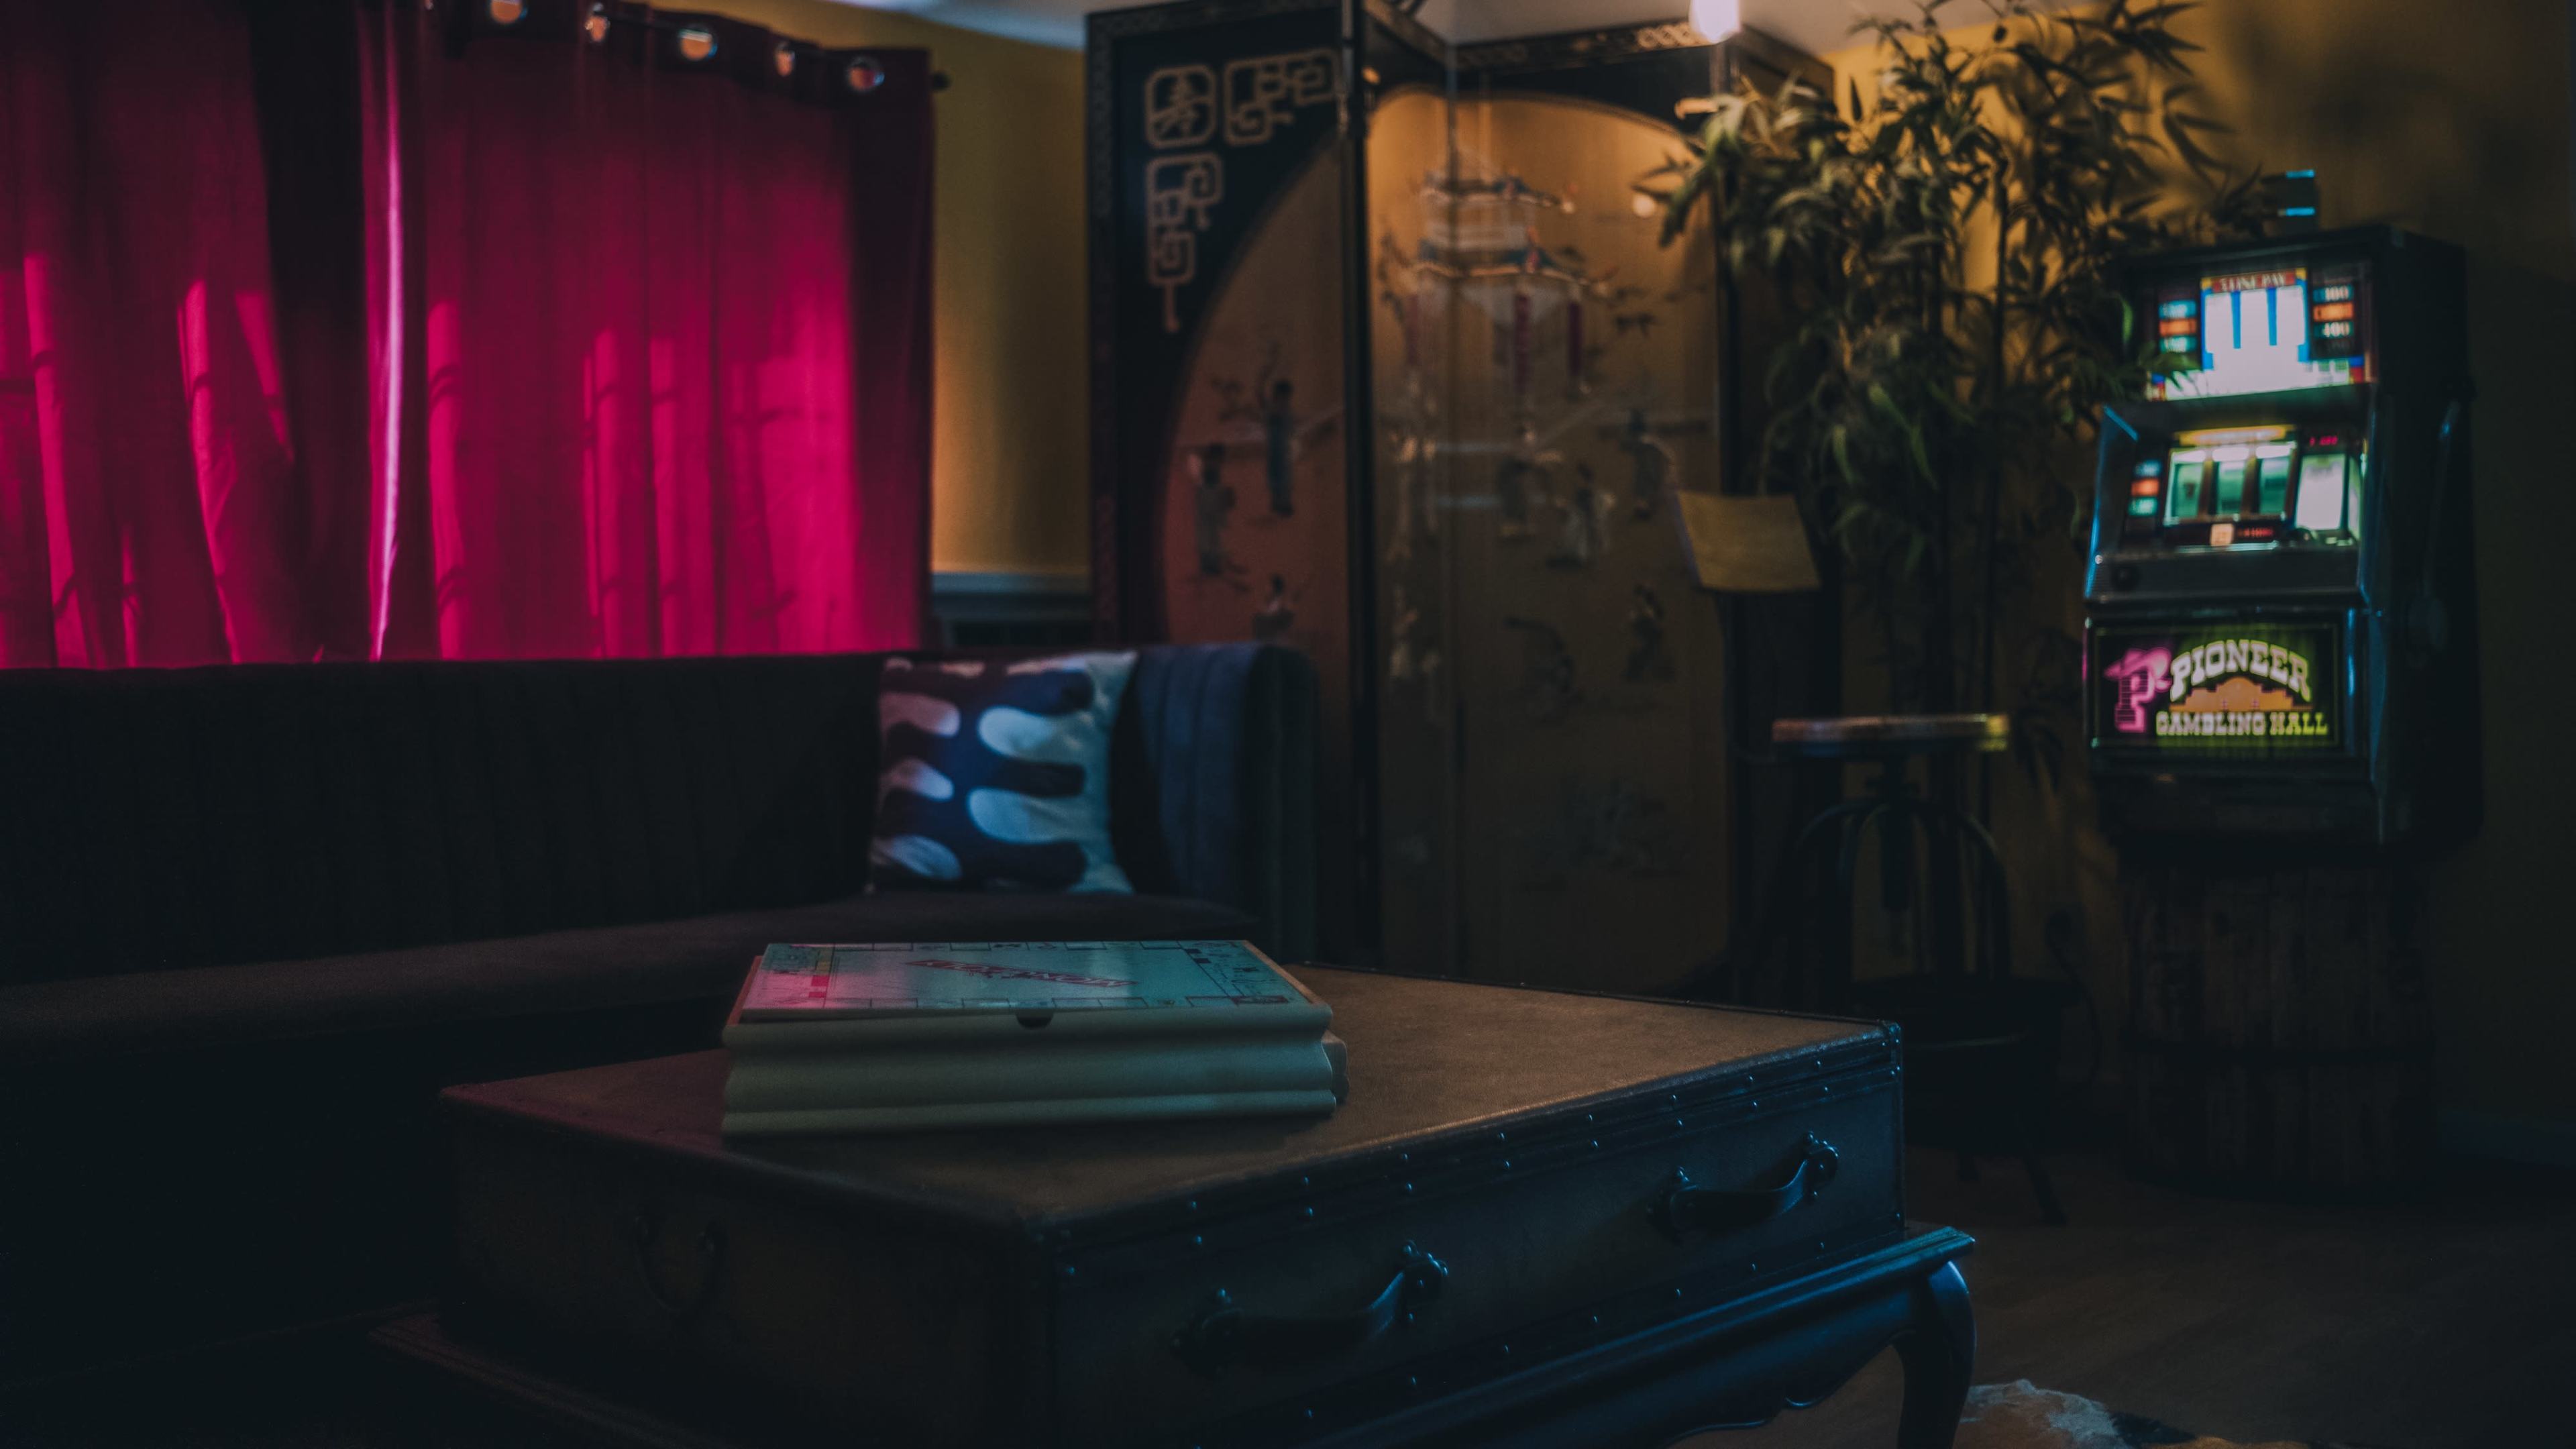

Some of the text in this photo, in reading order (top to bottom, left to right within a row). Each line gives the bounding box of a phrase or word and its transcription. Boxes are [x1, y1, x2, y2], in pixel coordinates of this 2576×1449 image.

[2170, 639, 2311, 702] PIONEER
[2156, 710, 2328, 736] GAMBLING HALL
[910, 960, 1132, 987] MONPOLY
